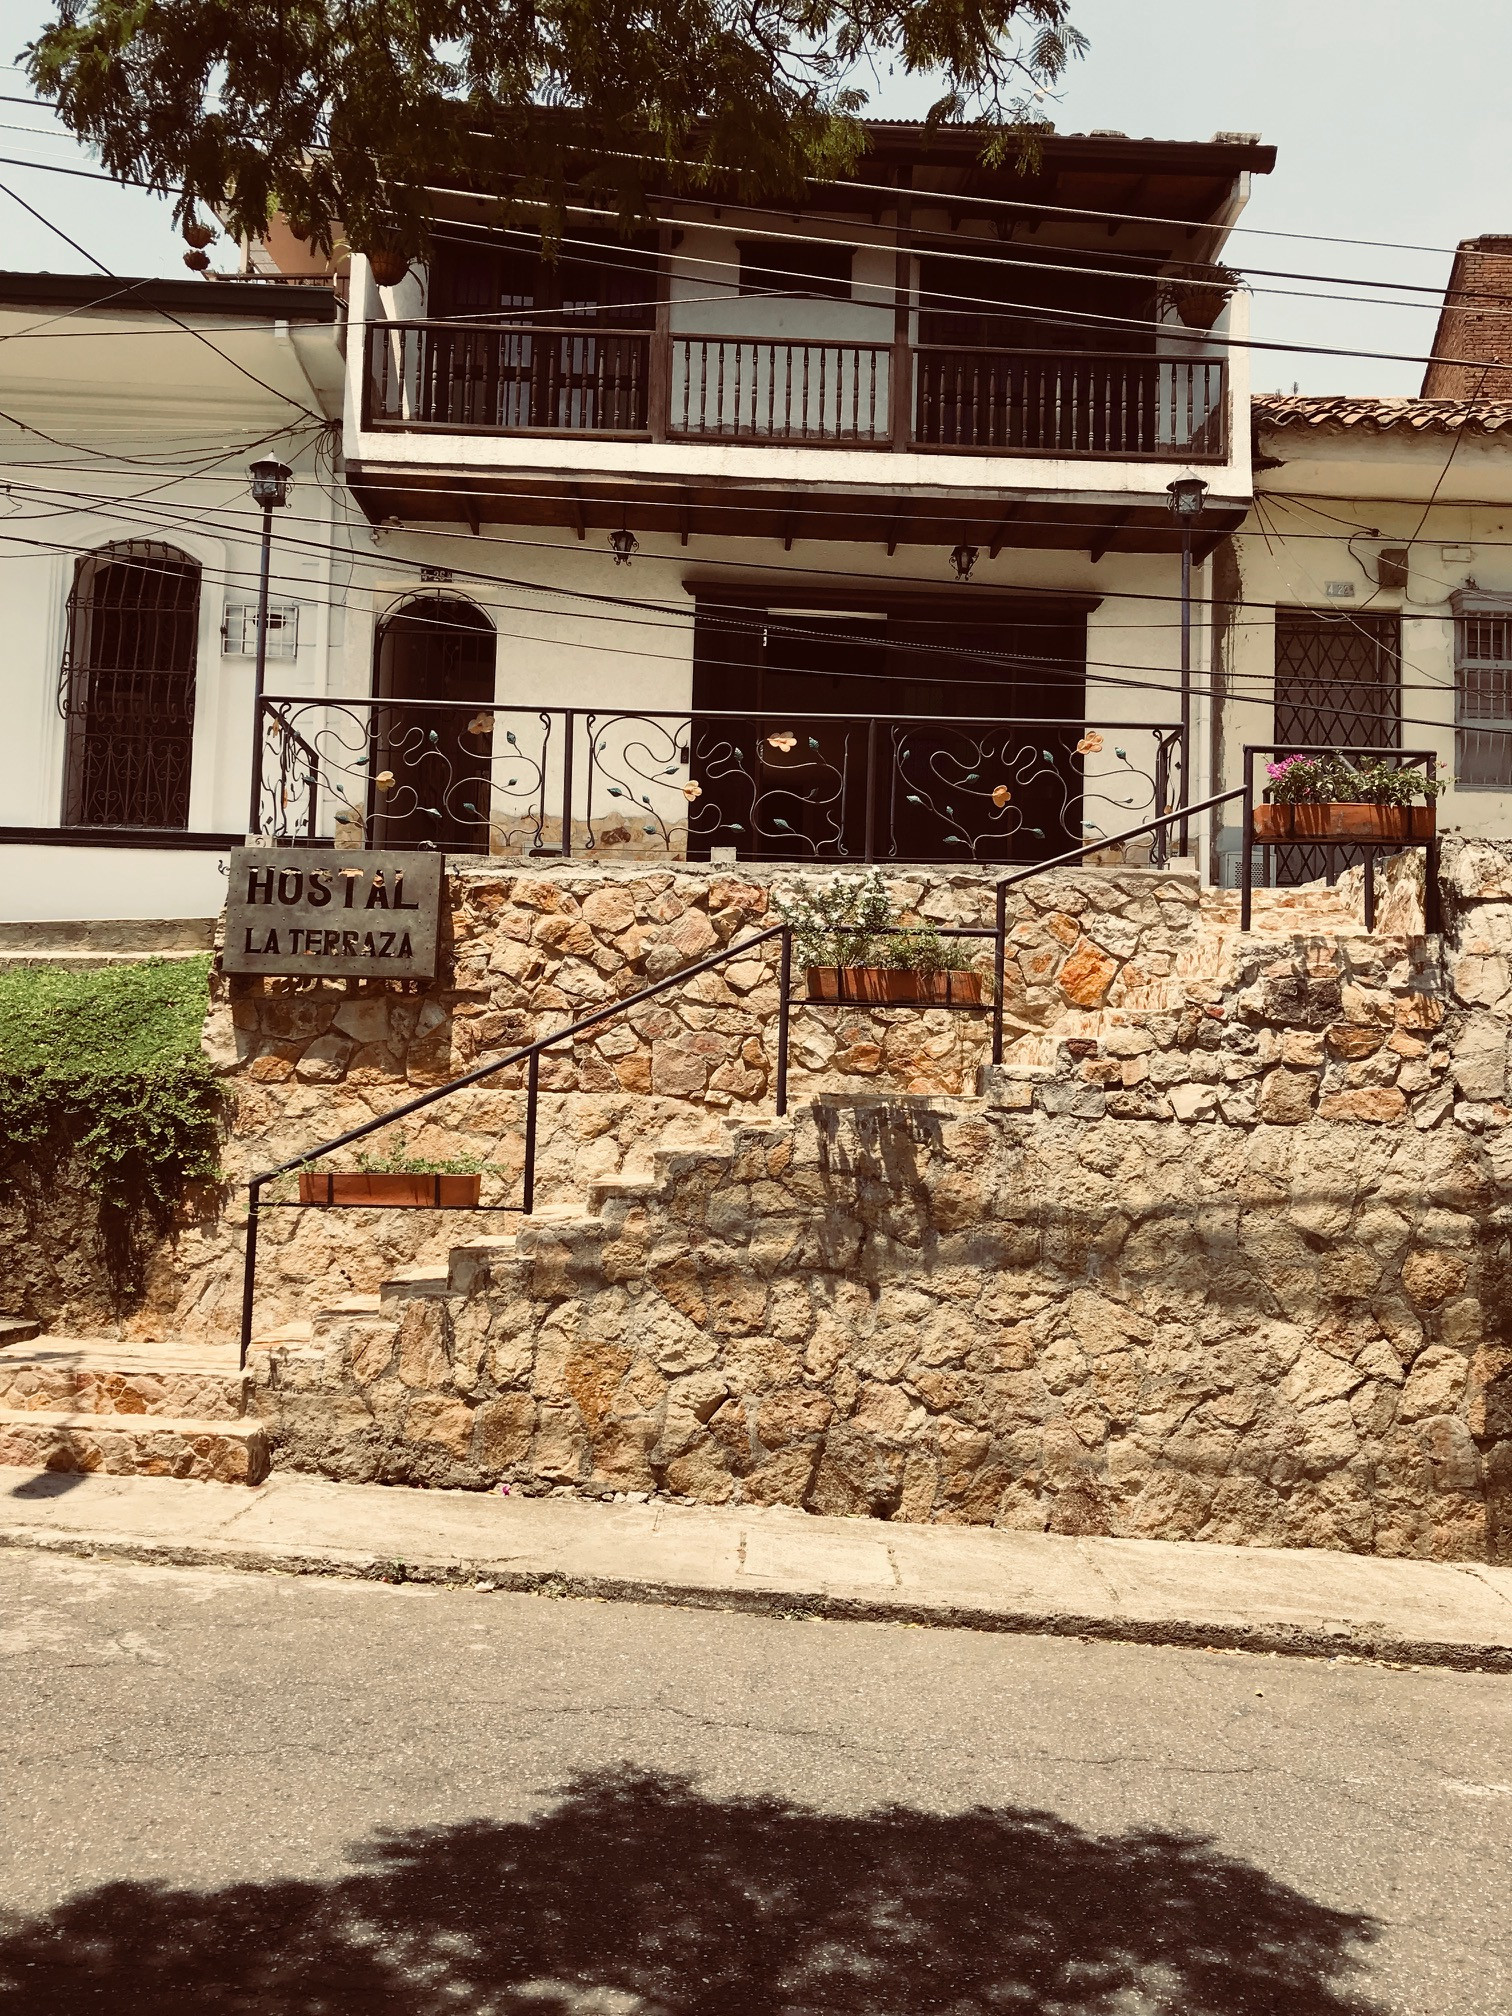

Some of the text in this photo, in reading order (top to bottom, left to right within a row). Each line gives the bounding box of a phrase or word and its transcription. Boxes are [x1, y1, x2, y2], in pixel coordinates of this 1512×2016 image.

[246, 865, 419, 909] HOSTAL
[243, 927, 413, 958] LA TERRAZA
